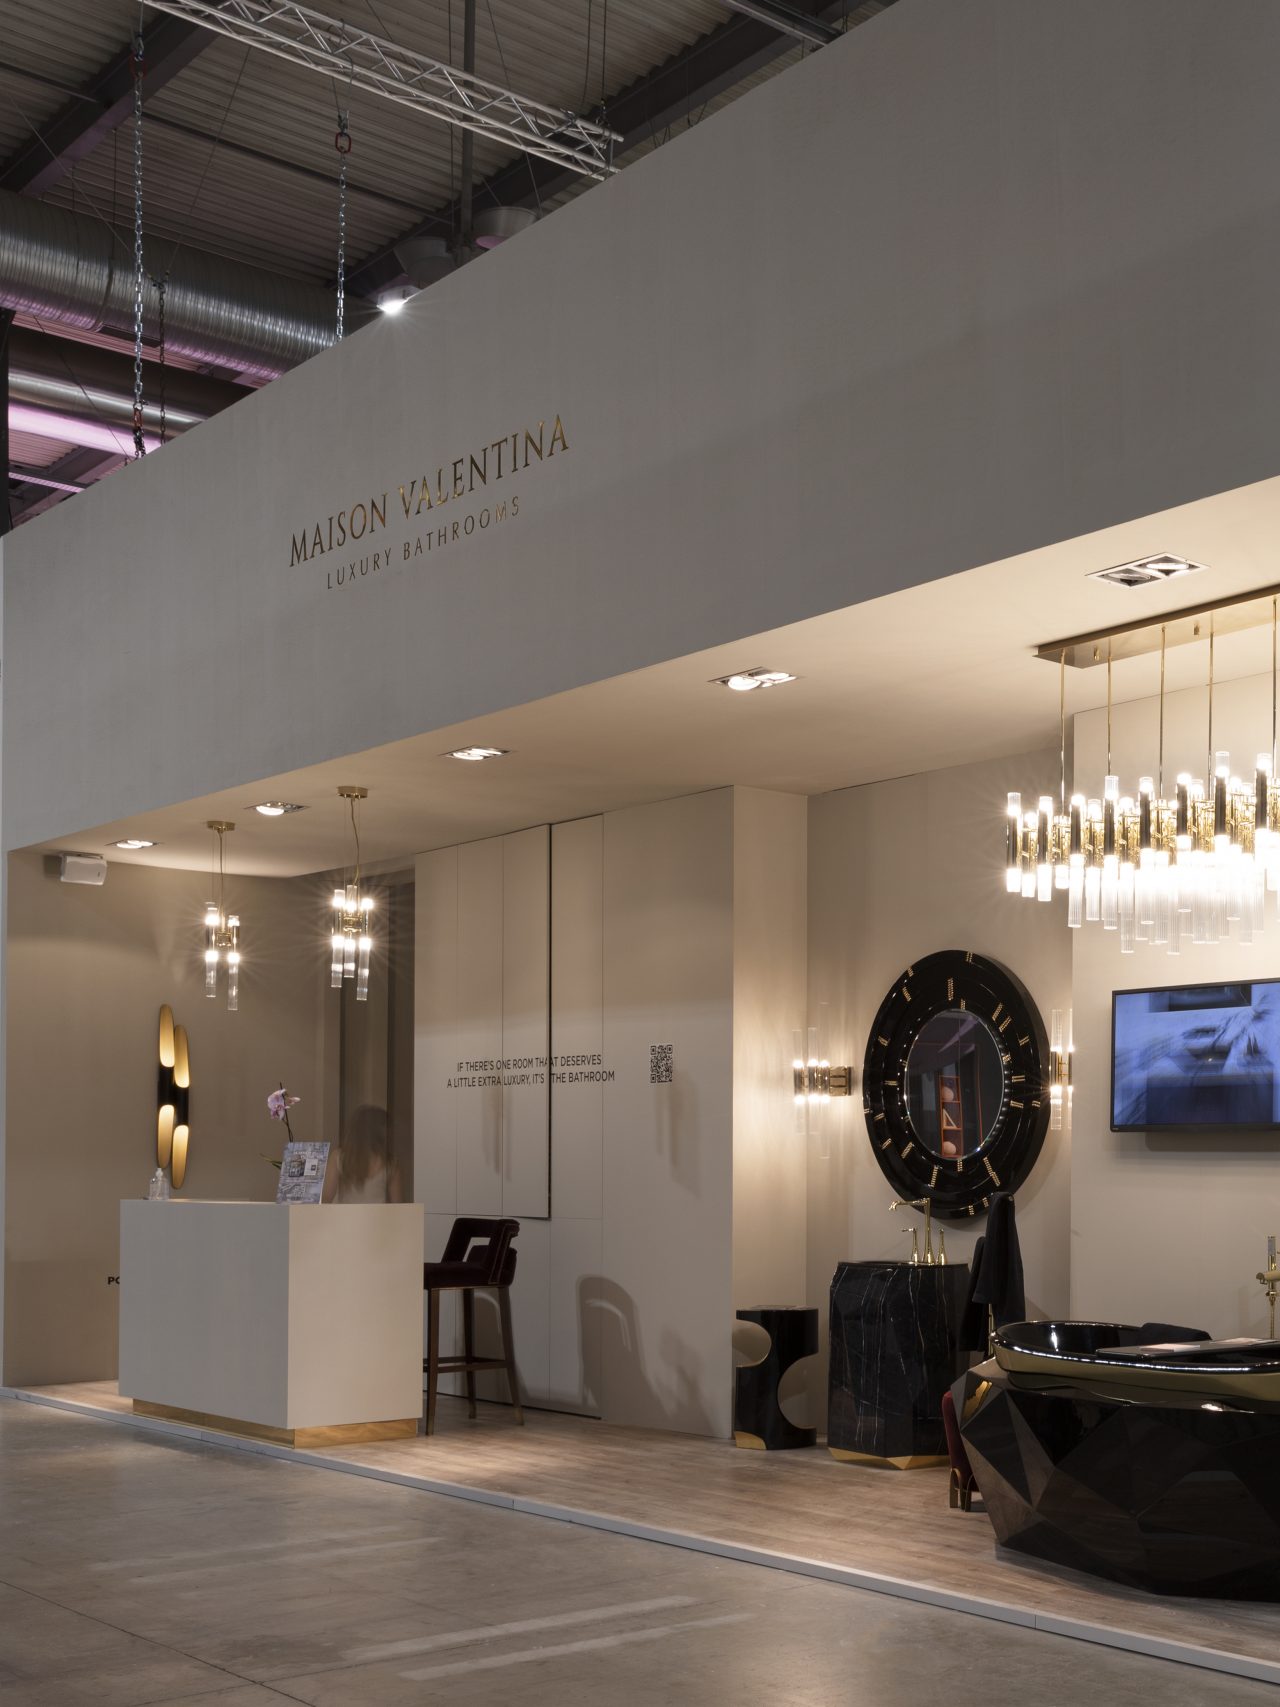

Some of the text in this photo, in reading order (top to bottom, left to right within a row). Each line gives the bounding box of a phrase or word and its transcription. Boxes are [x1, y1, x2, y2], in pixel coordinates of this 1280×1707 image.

[289, 414, 569, 567] MAISON VALENTINA
[327, 496, 519, 589] LUXURY BATHROOMS
[447, 1070, 616, 1088] A LITTLE EXTRA LUXURY, IT'S THE BATHROOM
[457, 1062, 464, 1072] IF
[465, 1060, 495, 1072] THERE'S
[496, 1059, 511, 1070] ONE
[512, 1058, 534, 1069] ROOM
[560, 1054, 602, 1067] DESERVES
